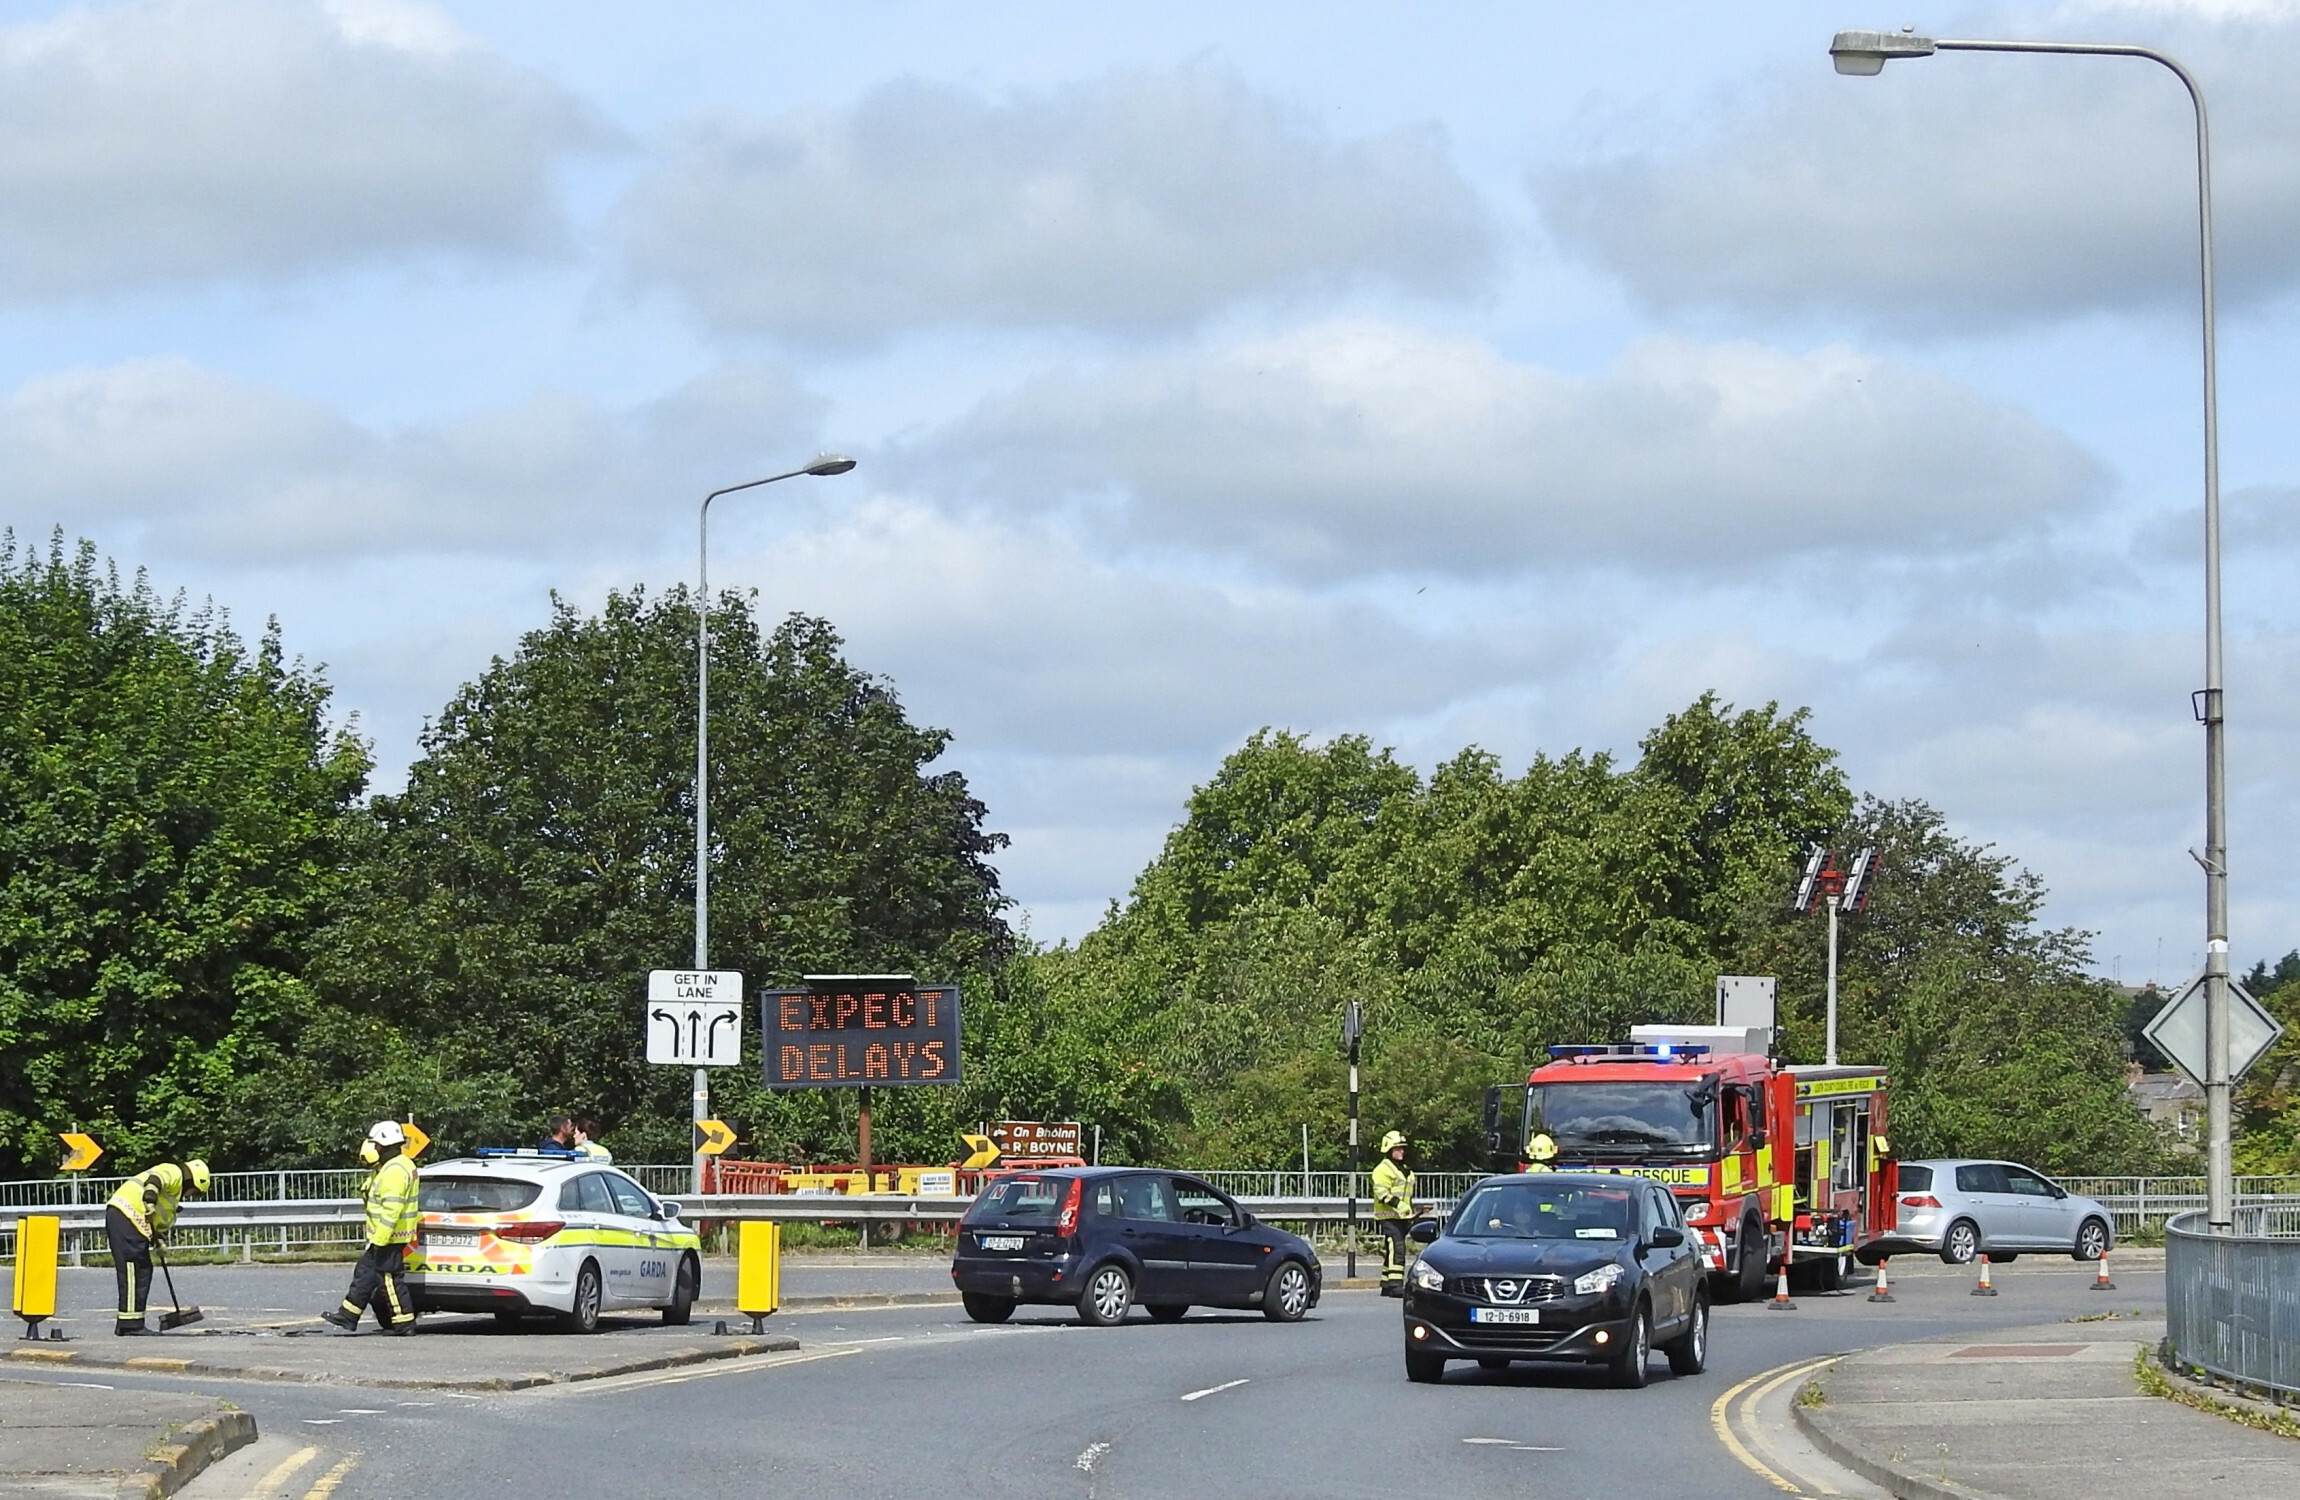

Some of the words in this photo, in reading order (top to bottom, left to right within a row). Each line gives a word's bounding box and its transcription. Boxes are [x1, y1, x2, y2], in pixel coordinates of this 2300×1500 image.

[674, 973, 700, 985] GET
[704, 974, 717, 985] IN
[677, 986, 713, 998] LANE
[779, 992, 942, 1030] EXPECT
[781, 1041, 945, 1080] DELAYS
[1013, 1127, 1030, 1138] An
[1030, 1141, 1074, 1153] BOYNE
[640, 1260, 666, 1278] GARDA
[1485, 1311, 1530, 1323] 12-D-6918
